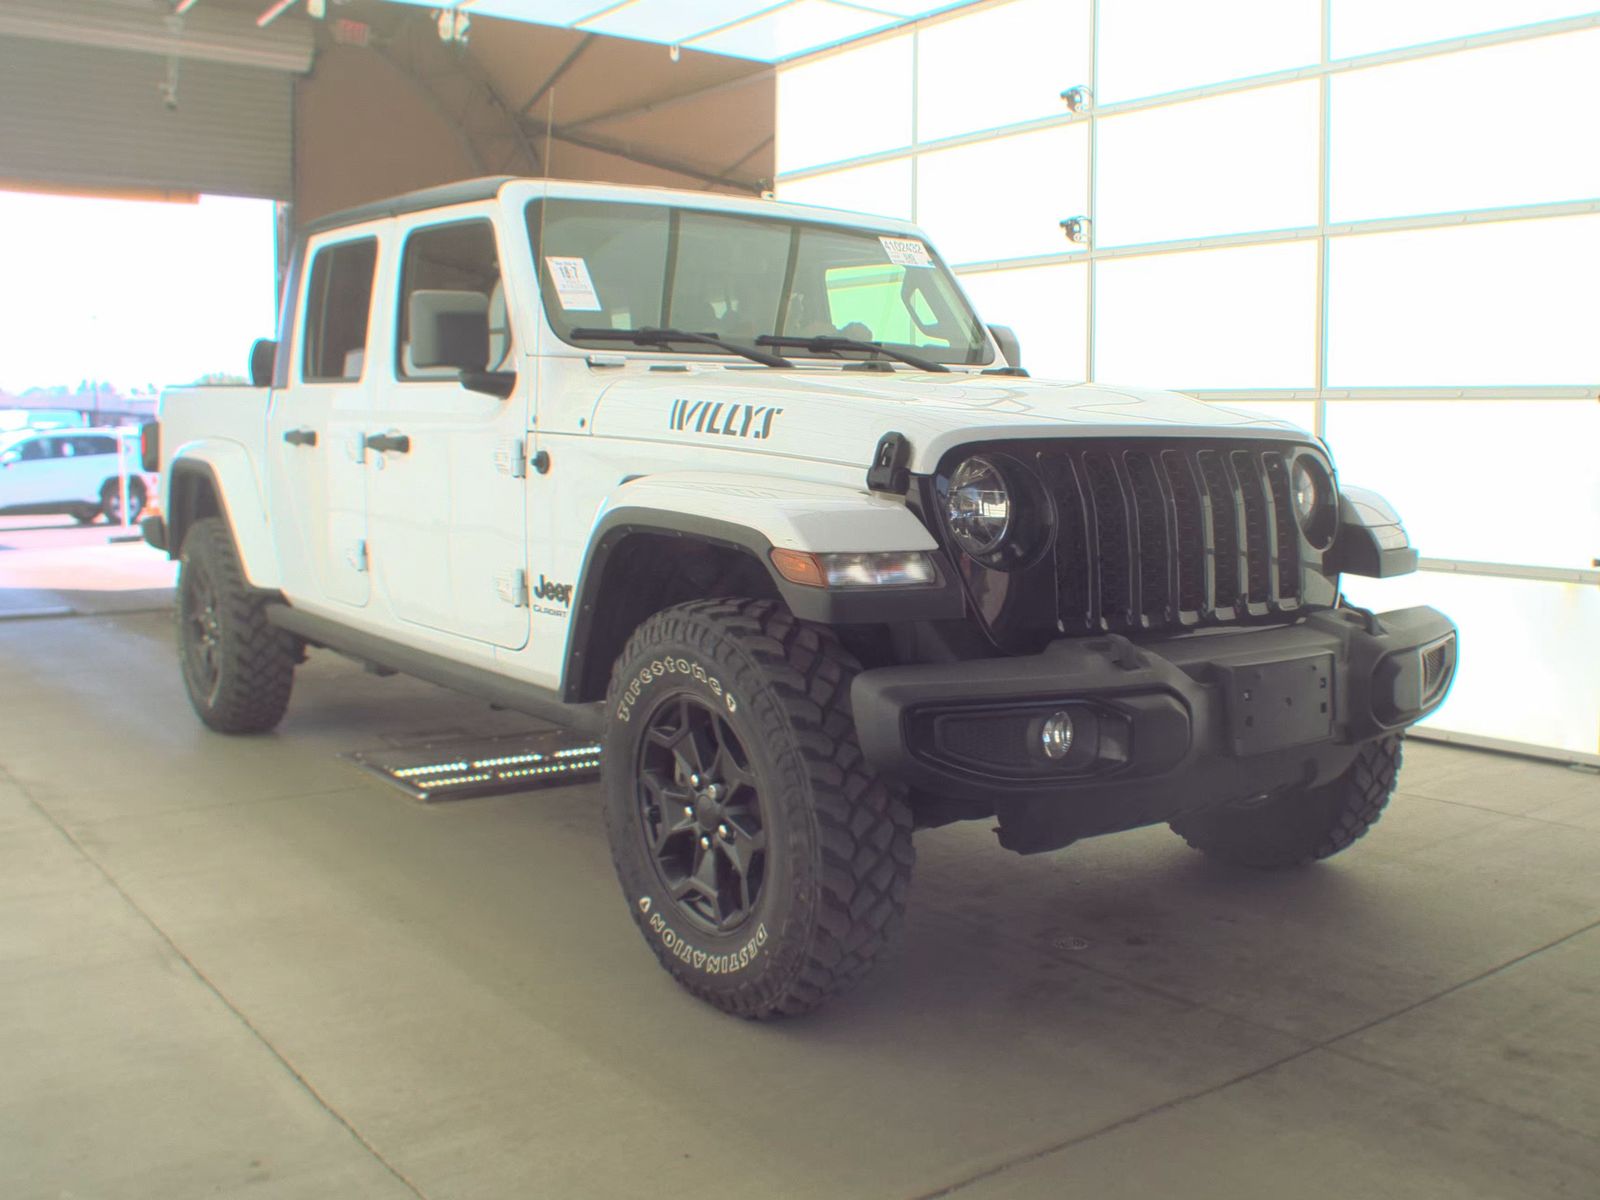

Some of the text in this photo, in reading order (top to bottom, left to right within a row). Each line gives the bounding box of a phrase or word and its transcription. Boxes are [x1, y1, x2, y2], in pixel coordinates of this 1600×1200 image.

[669, 399, 784, 439] WILLYS
[617, 656, 722, 722] Firestone
[650, 913, 768, 974] DESTINATION
